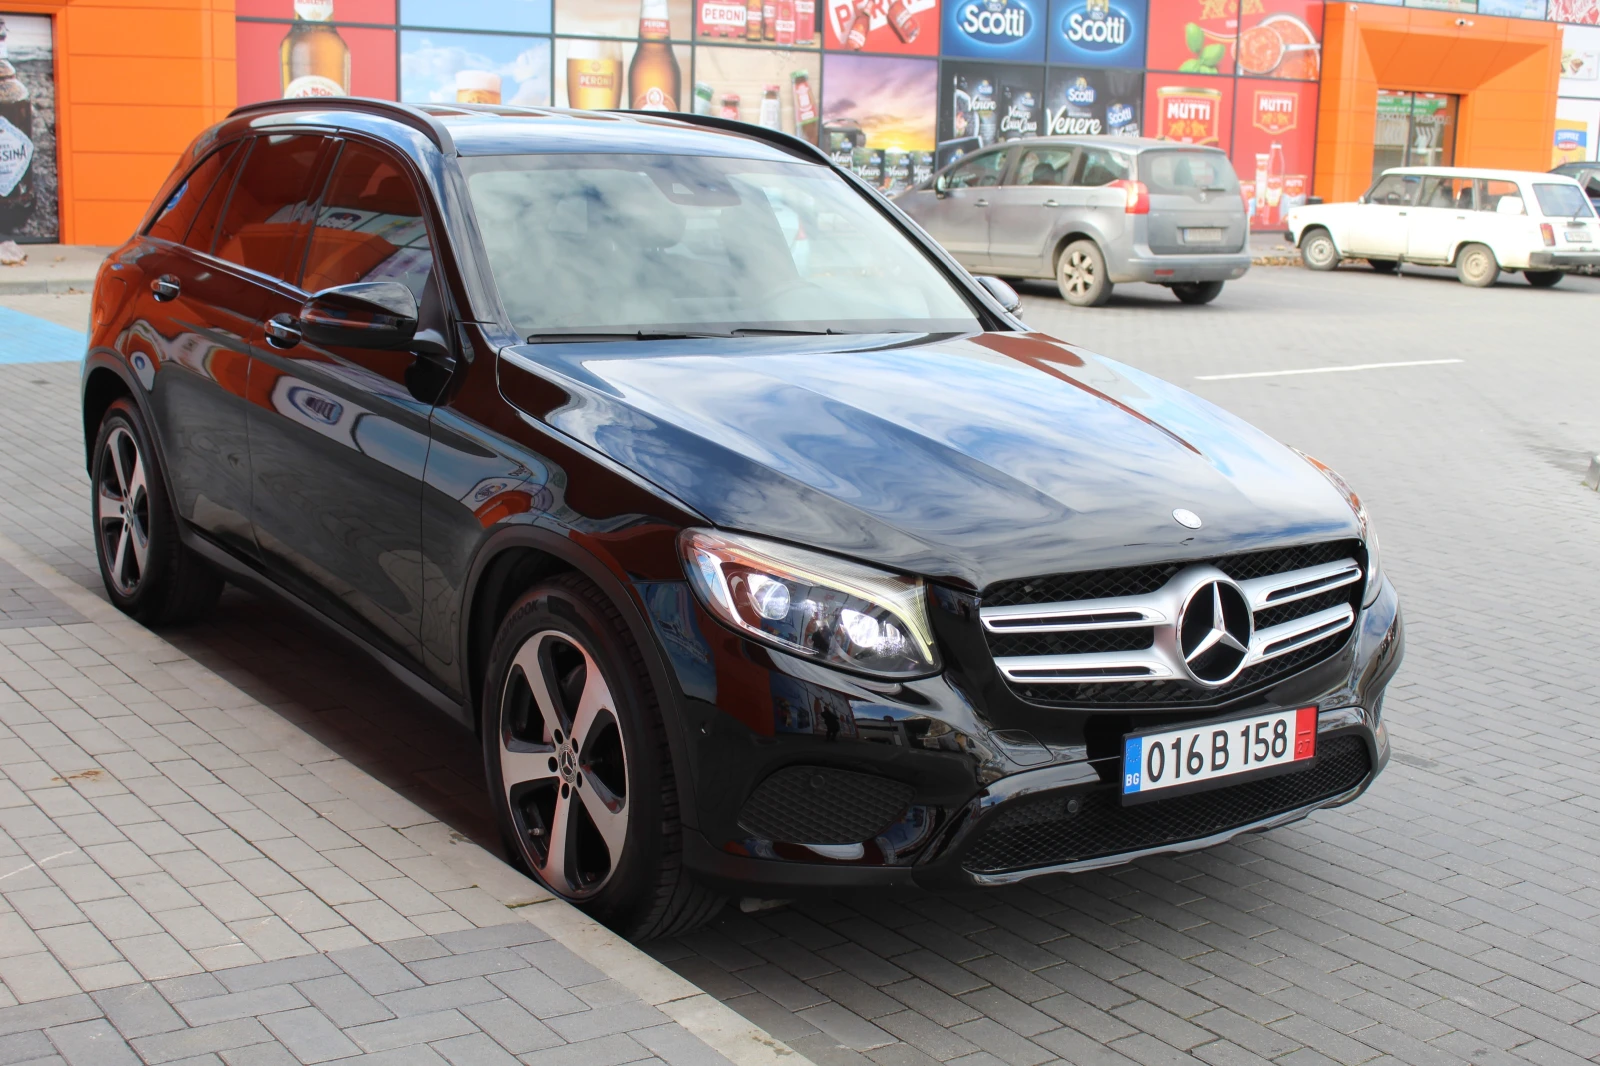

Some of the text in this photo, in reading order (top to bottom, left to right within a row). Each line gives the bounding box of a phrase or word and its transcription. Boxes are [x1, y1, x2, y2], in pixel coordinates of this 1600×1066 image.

[704, 8, 745, 21] PERONI
[963, 4, 1025, 37] Scotti
[1068, 13, 1124, 44] Scotti
[971, 95, 997, 111] Venere
[1068, 88, 1094, 103] Scotti
[1166, 103, 1211, 120] MUTTI
[1259, 98, 1292, 112] MUTTI
[1046, 104, 1102, 136] Venere
[1108, 107, 1132, 125] Scotti
[1297, 739, 1311, 755] 27
[1125, 773, 1140, 787] BG
